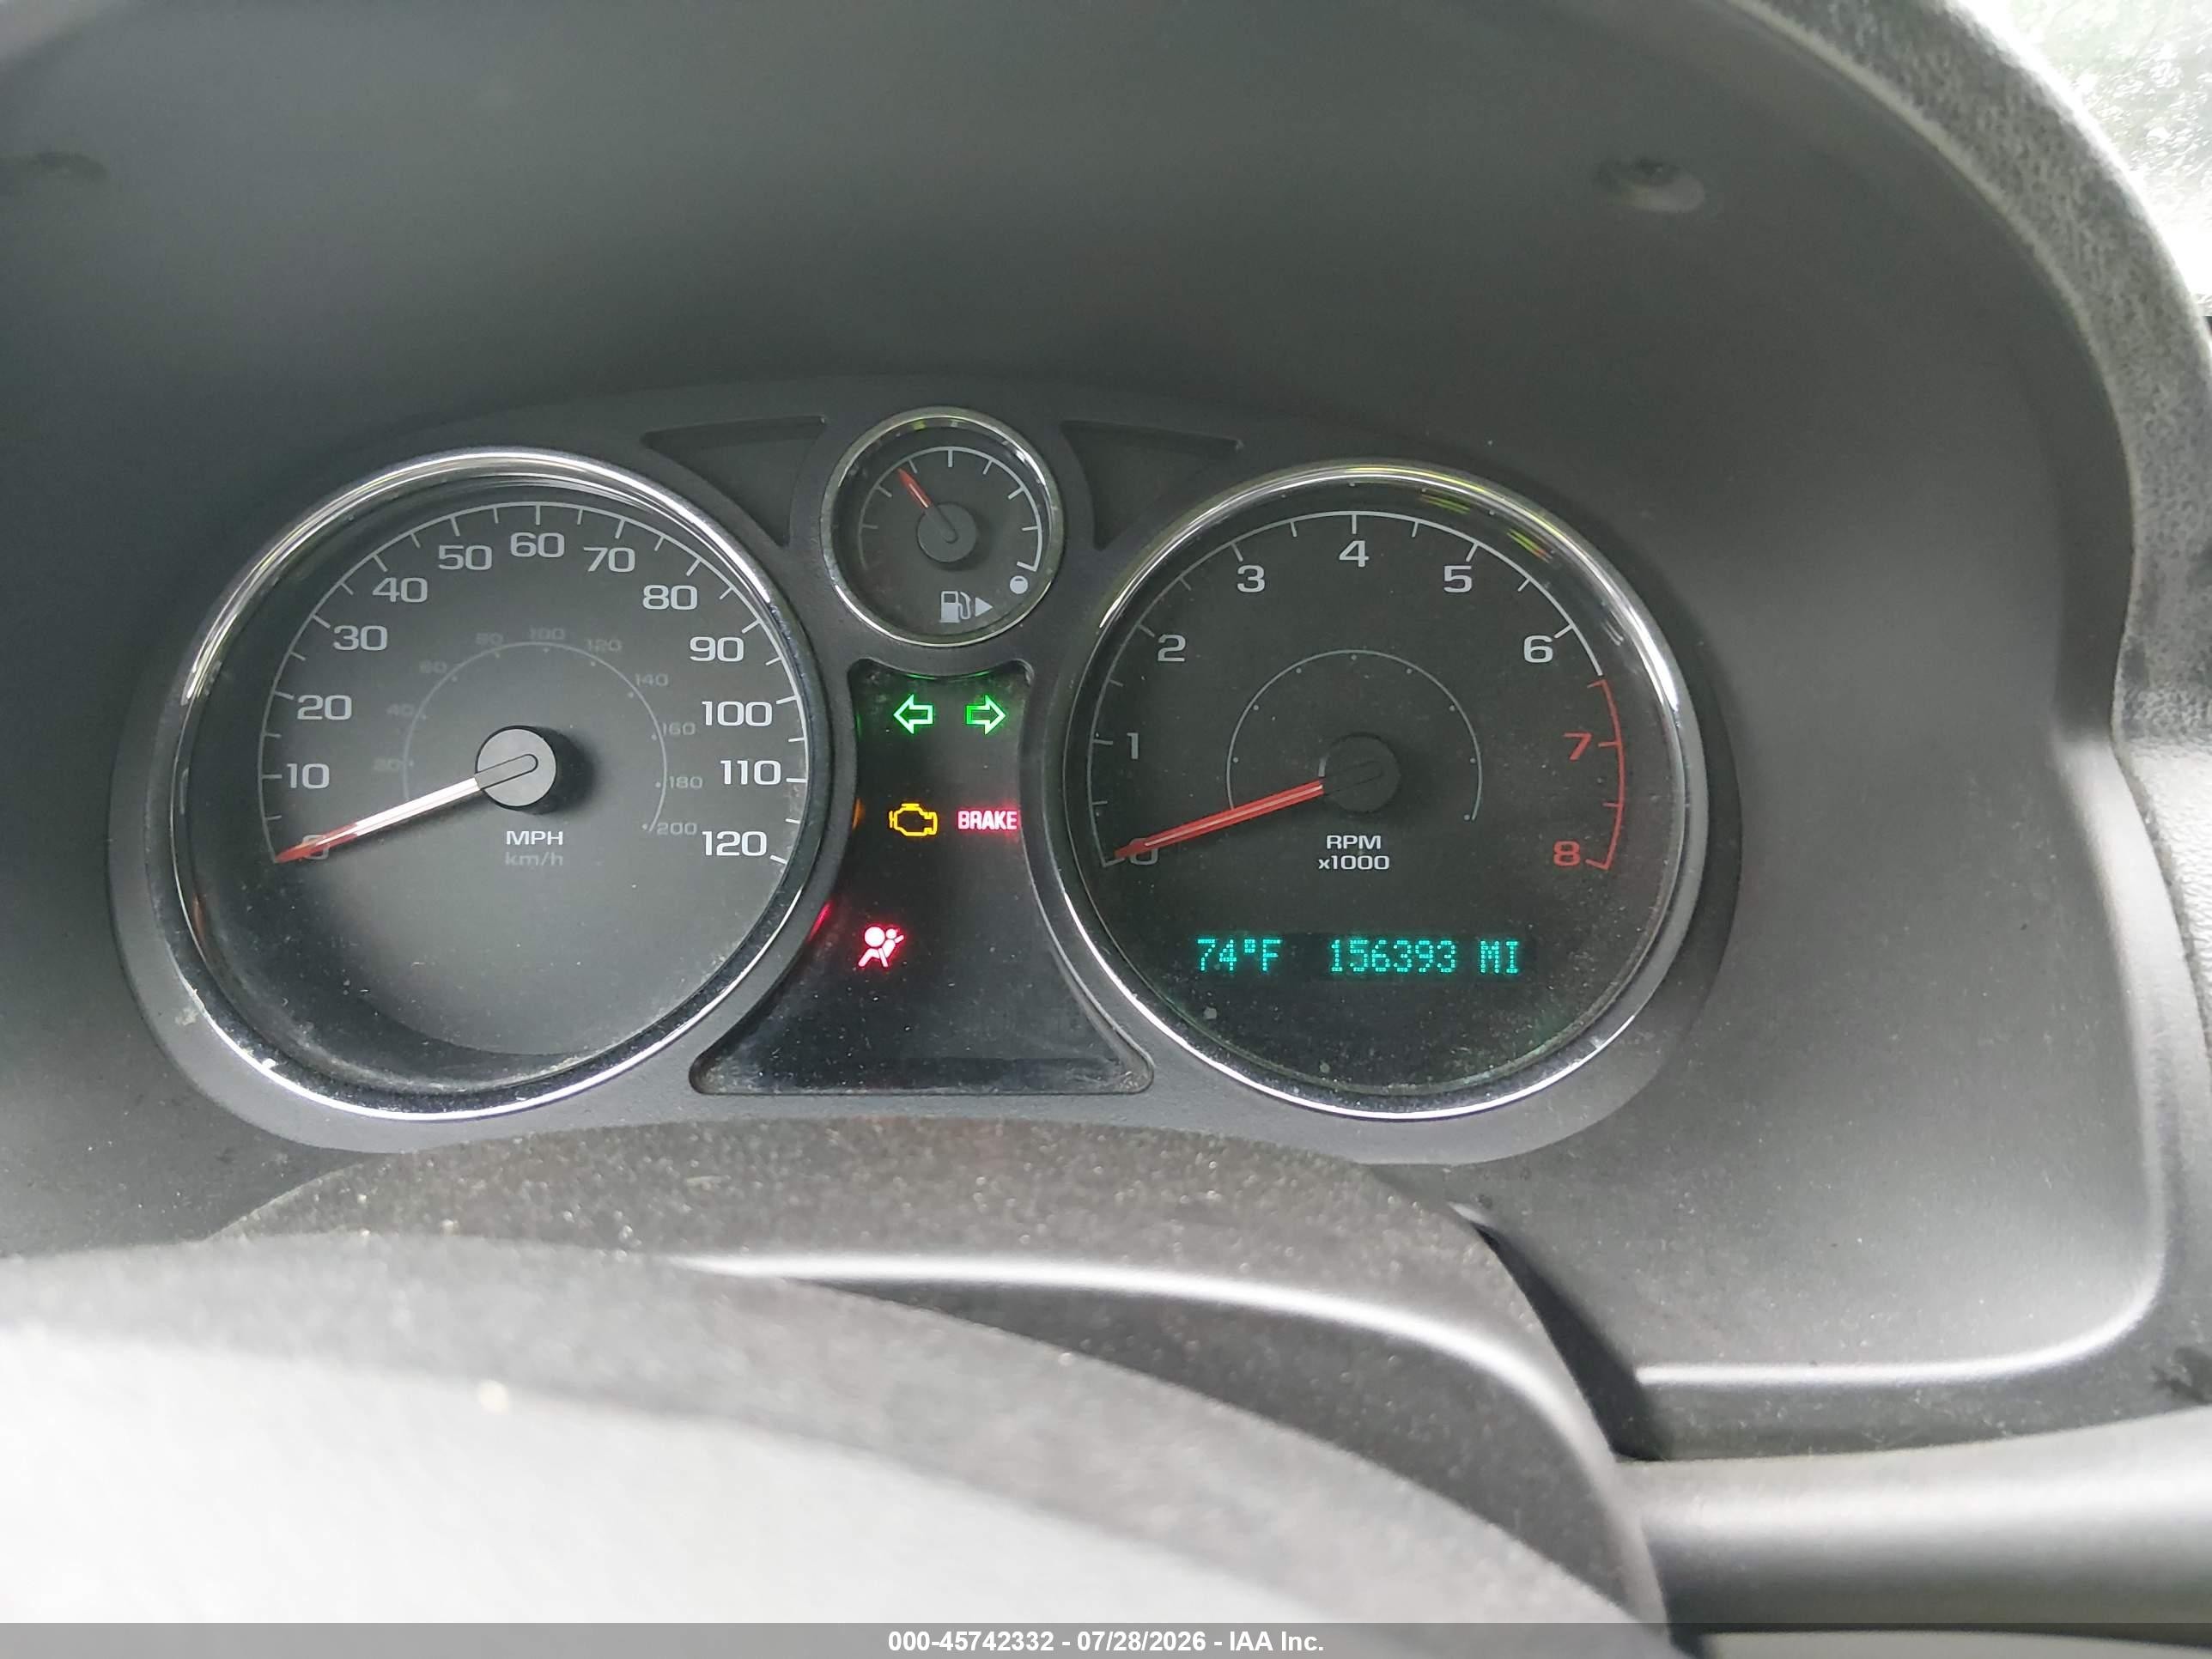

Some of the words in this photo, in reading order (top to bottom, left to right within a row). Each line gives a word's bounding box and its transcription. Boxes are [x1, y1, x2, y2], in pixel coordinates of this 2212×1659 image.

[439, 545, 492, 572] 50
[510, 533, 565, 558] 60
[1339, 540, 1369, 568] 4
[584, 547, 636, 573] 70
[372, 577, 428, 603] 40
[1237, 566, 1266, 592] 3
[1443, 566, 1473, 592] 5
[642, 585, 698, 611] 80
[333, 625, 387, 651] 30
[690, 637, 744, 662] 90
[1158, 635, 1187, 662] 2
[1523, 635, 1553, 663] 6
[635, 673, 669, 686] 140
[297, 695, 352, 720] 20
[702, 701, 772, 727] 100
[662, 721, 696, 736] 160
[1127, 733, 1140, 759] 1
[1564, 734, 1591, 761] 7
[288, 763, 330, 789] 10
[671, 776, 703, 790] 180
[720, 760, 781, 786] 110
[656, 823, 697, 836] 200
[957, 810, 1018, 830] BRAKE
[505, 830, 563, 846] MPH
[702, 830, 768, 857] 120
[1326, 836, 1382, 850] RPM
[505, 852, 563, 867] km/h
[1318, 855, 1390, 871] x1000
[1553, 841, 1580, 867] 8
[1330, 939, 1456, 974] 156393
[1480, 940, 1521, 975] MI
